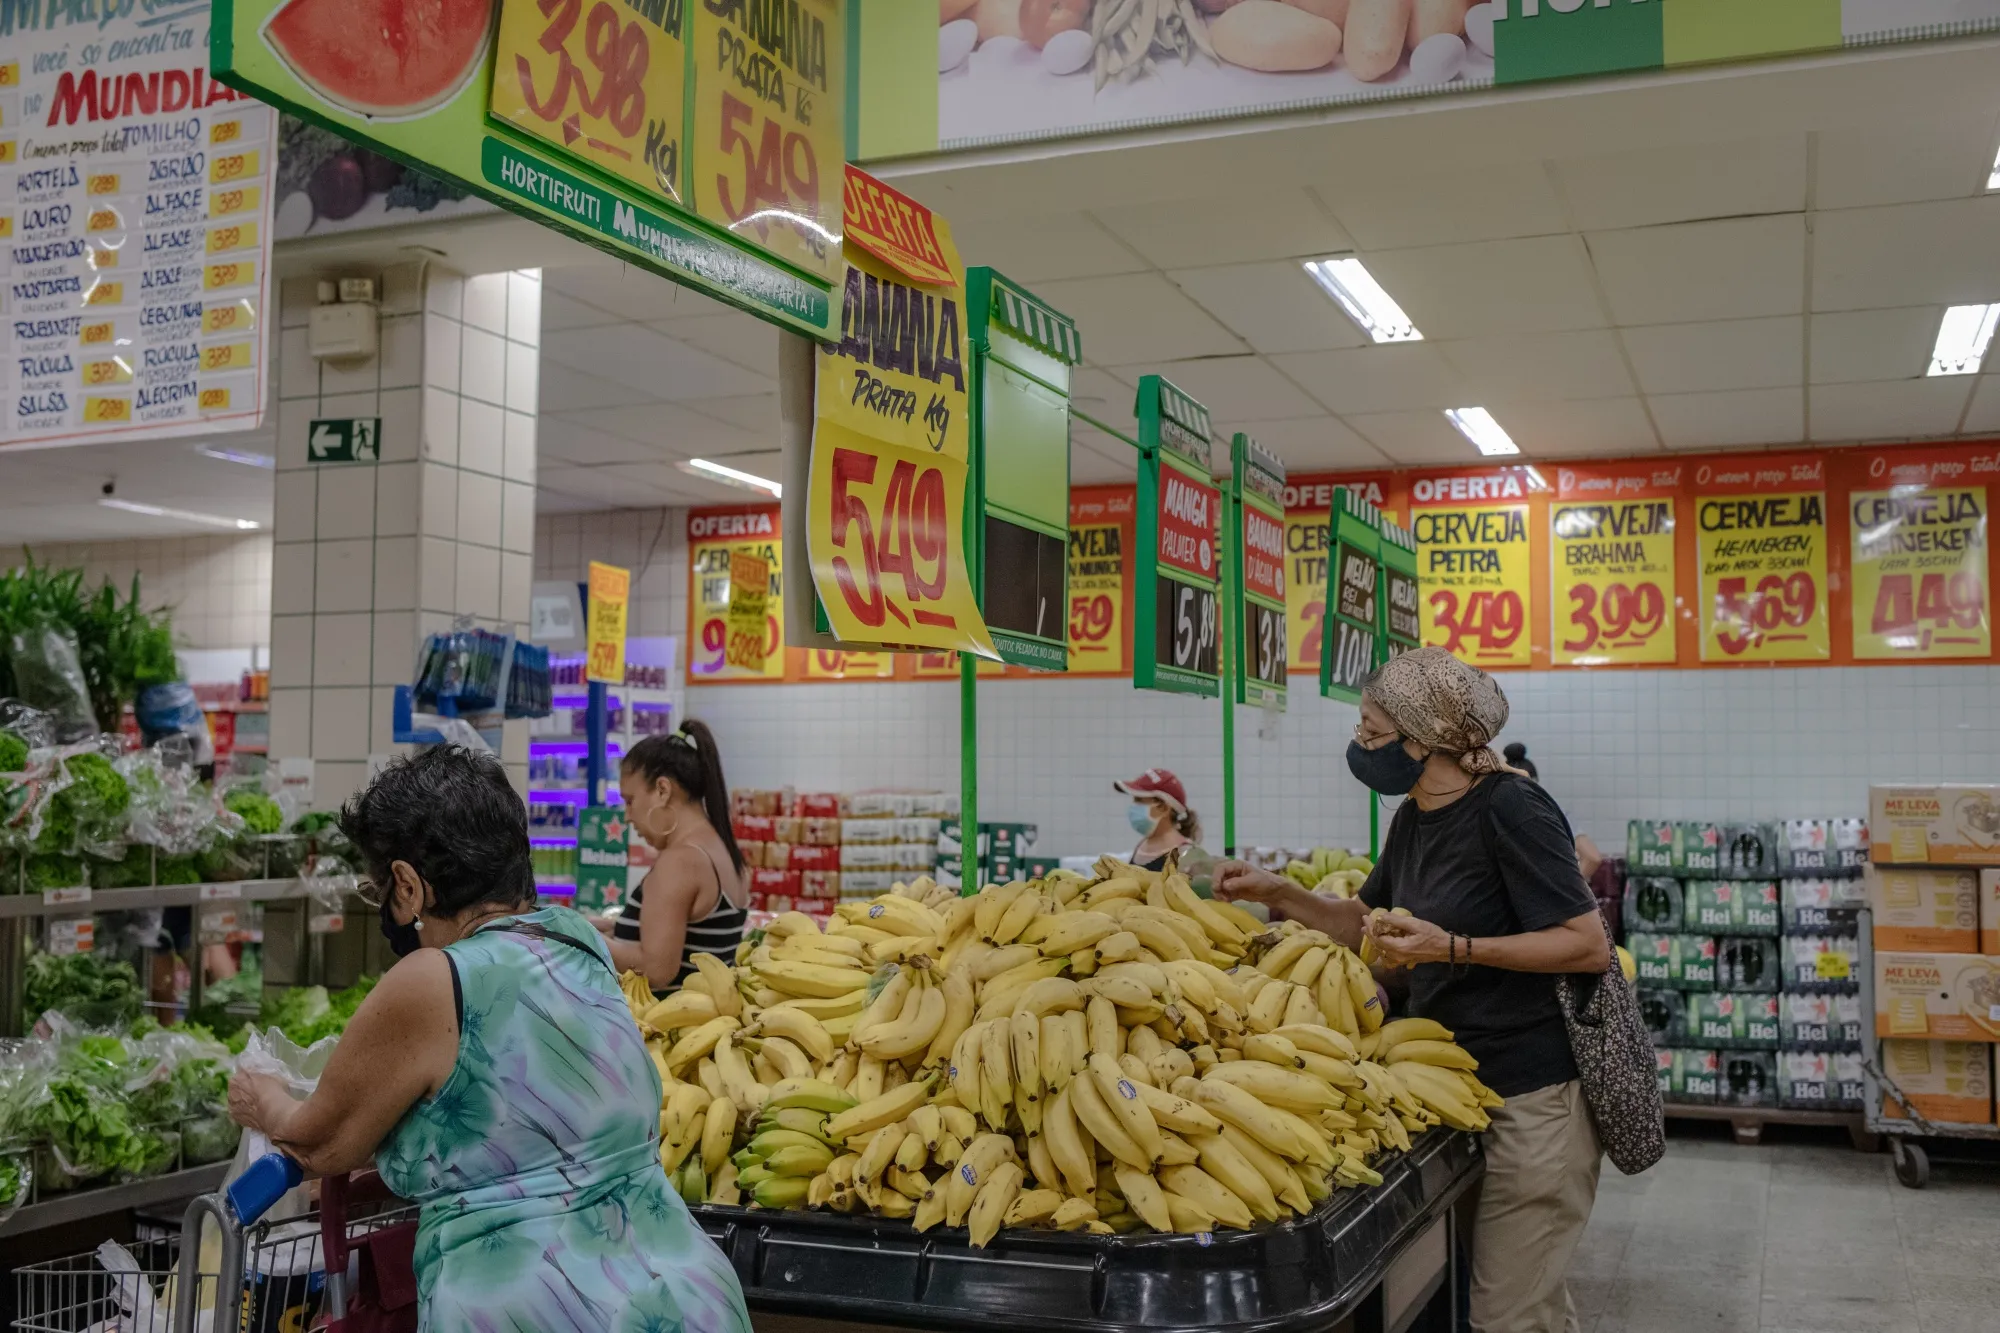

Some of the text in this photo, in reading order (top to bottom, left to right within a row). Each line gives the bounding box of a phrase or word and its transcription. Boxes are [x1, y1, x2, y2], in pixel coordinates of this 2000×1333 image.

[33, 43, 70, 75] você
[78, 36, 105, 67] só
[108, 23, 194, 62] encontra
[717, 26, 787, 113] PRATA
[122, 117, 201, 150] TOMILHO
[17, 160, 80, 191] HORTELÃ
[146, 188, 202, 214] ALFACE
[501, 155, 601, 223] HORTIFRUTI
[23, 204, 71, 230] LOURO
[844, 170, 944, 268] OFERTA
[144, 229, 190, 251] ALFACE
[12, 277, 81, 300] MOSTARDA
[141, 267, 182, 288] ALFACE
[13, 316, 82, 339] RABANETE
[821, 265, 966, 394] ANANA
[17, 391, 69, 416] SALSA
[136, 381, 198, 410] ALECRIM
[852, 369, 949, 452] PRATA Kg
[1695, 465, 1711, 486] O
[1870, 456, 1886, 478] O
[1931, 461, 1966, 481] preço
[1413, 476, 1522, 501] OFERTA
[1164, 478, 1208, 529] MANGA
[1700, 496, 1823, 532] CERVEJA
[1854, 492, 1982, 530] CERVEJA
[690, 512, 773, 537] OFERTA
[1414, 509, 1527, 546] CERVEJA
[1554, 502, 1676, 539] CERVEJA
[1162, 527, 1197, 565] PALMER
[1566, 541, 1647, 566] BRAHMA
[1714, 534, 1812, 557] HEINEKEN
[1430, 549, 1502, 573] PETRA
[1344, 555, 1376, 593] MELÃO
[1884, 799, 1941, 810] ME LEVA
[1701, 909, 1730, 925] Hei
[1747, 909, 1777, 926] Hei
[1640, 962, 1669, 979] Hei
[1685, 964, 1714, 981] Hei
[1884, 967, 1941, 979] ME LEVA
[1703, 1021, 1733, 1038] Hei
[1687, 1077, 1716, 1094] Hei
